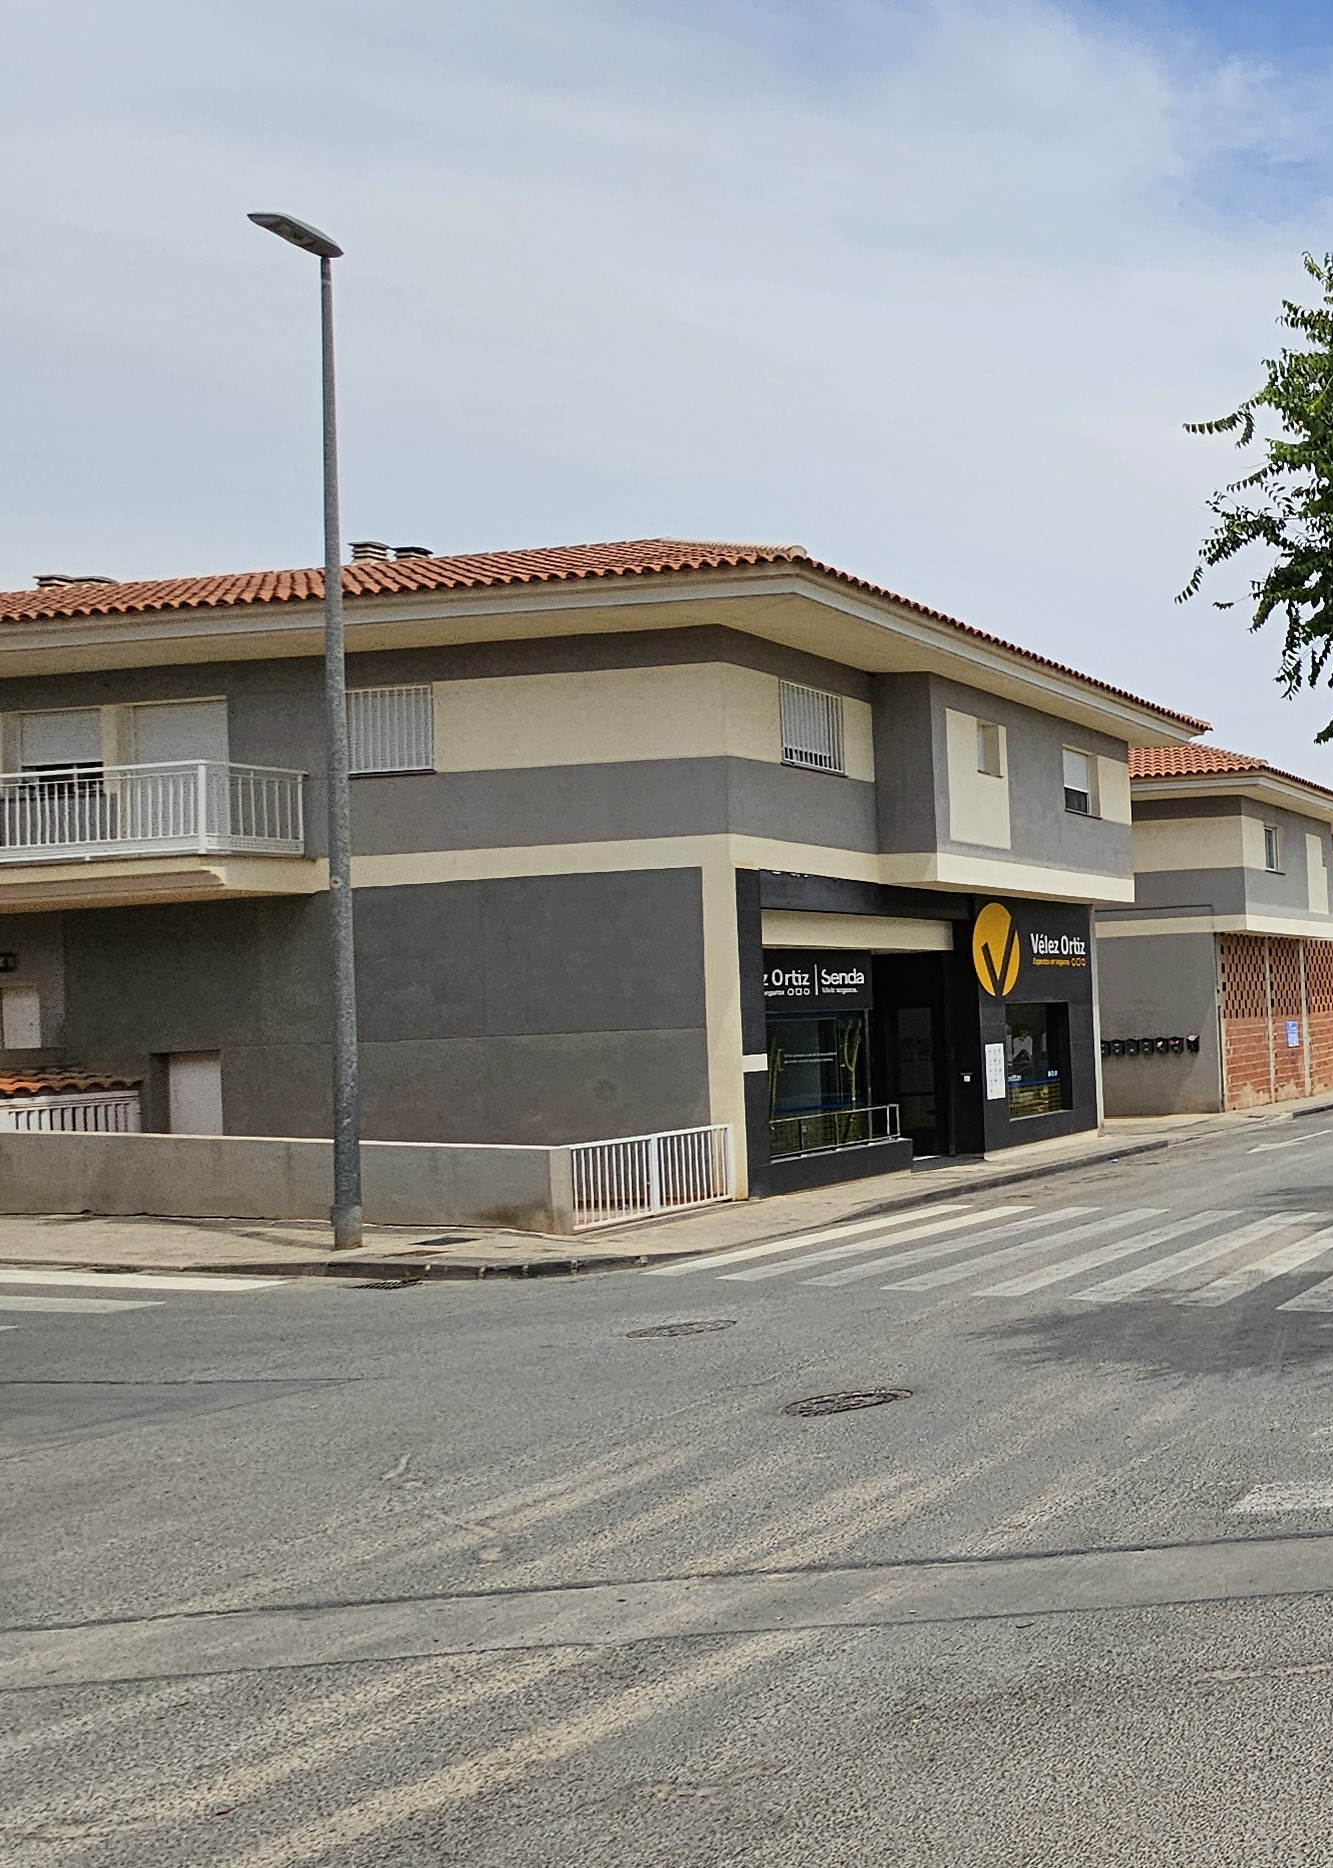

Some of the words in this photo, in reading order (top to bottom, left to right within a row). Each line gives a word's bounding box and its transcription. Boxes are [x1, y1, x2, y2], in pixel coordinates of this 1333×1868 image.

[1030, 933, 1060, 955] Vélez
[1060, 935, 1086, 955] Ortiz
[771, 968, 811, 986] Ortiz
[820, 967, 865, 985] Senda
